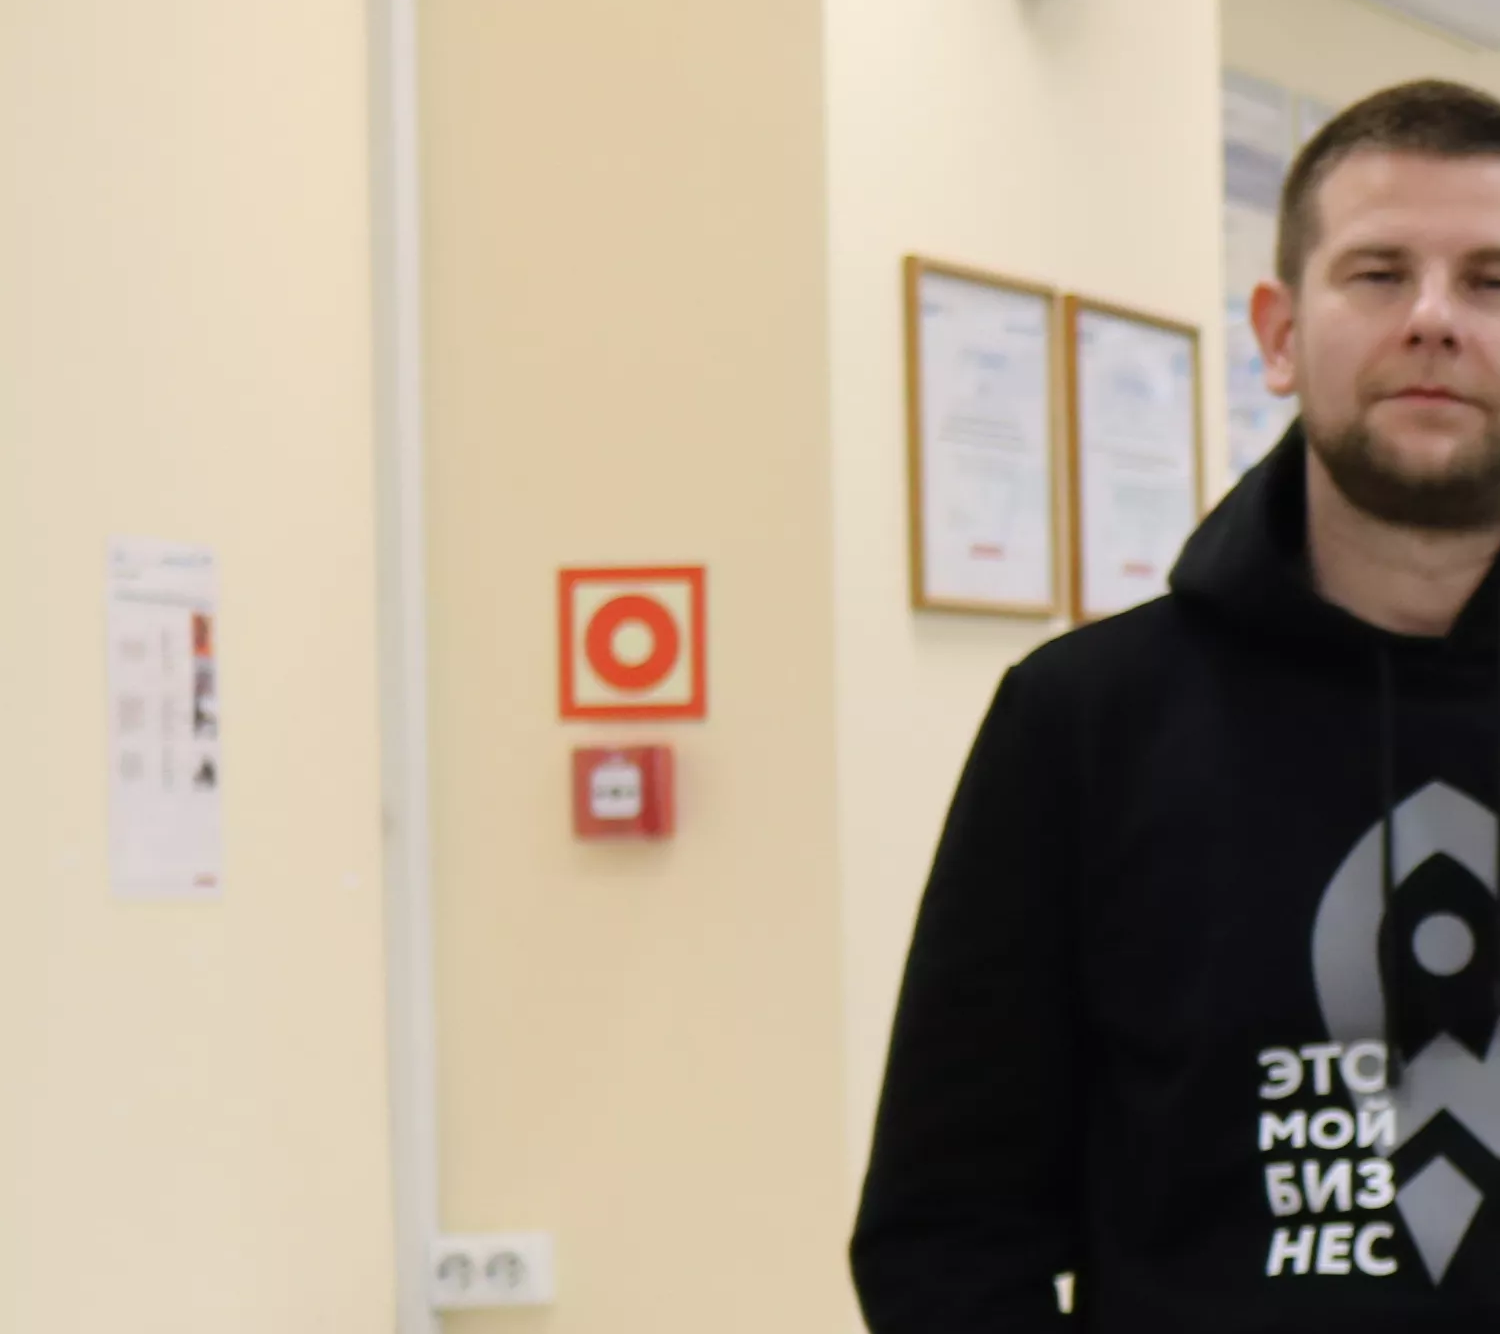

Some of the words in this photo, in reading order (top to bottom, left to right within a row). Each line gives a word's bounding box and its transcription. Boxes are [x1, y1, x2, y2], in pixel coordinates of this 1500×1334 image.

[1258, 1098, 1397, 1151] МОЙ
[1264, 1157, 1396, 1217] БИЗ
[1265, 1221, 1398, 1277] НЕС
